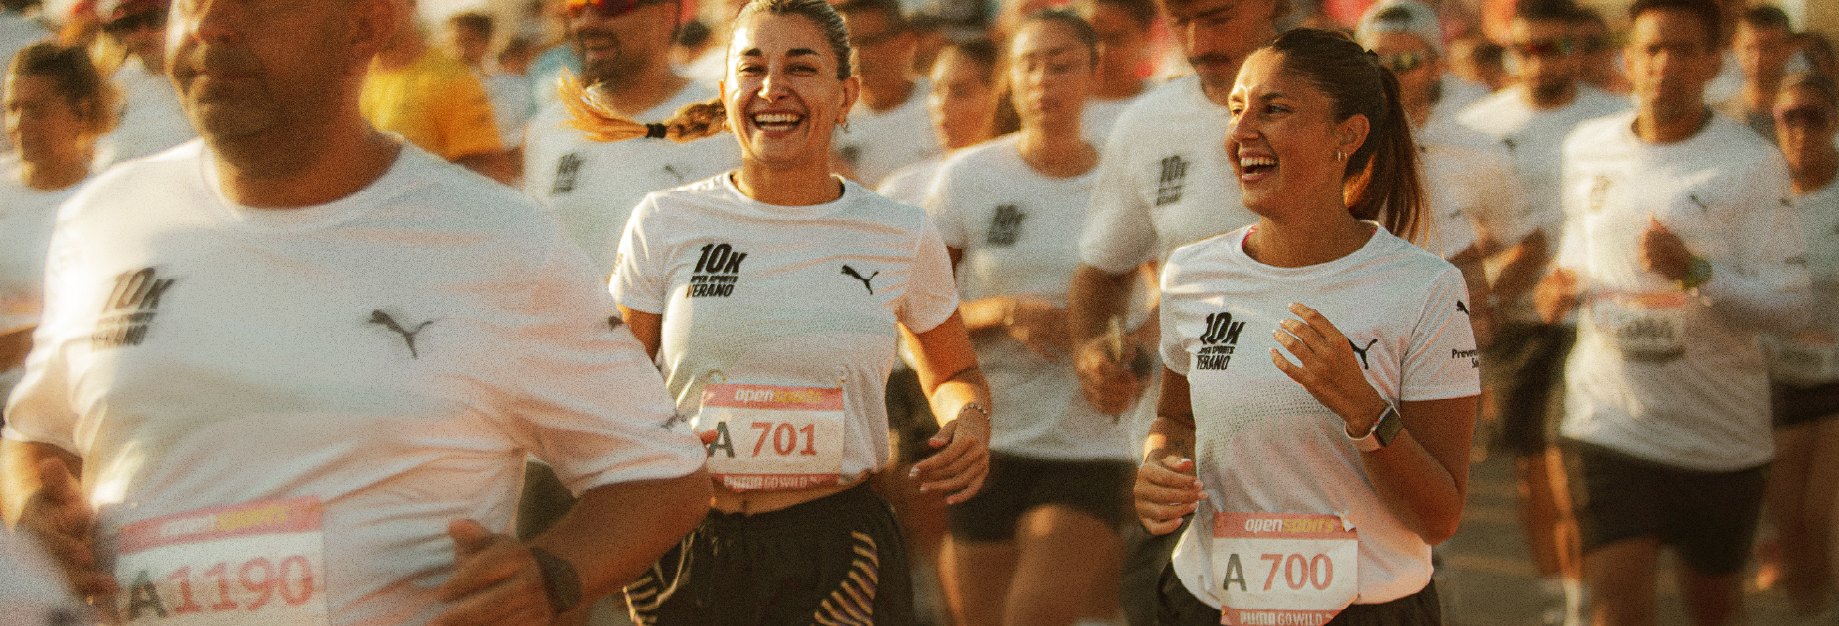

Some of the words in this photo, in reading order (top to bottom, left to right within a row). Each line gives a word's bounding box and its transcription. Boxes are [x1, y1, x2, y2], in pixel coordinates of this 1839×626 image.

[686, 283, 735, 298] VERANO
[708, 421, 736, 459] A
[750, 421, 818, 458] 701
[1244, 518, 1336, 534] opensports
[129, 570, 169, 619] A
[168, 555, 314, 615] 1190
[1222, 552, 1248, 592] A
[1260, 552, 1334, 592] 700
